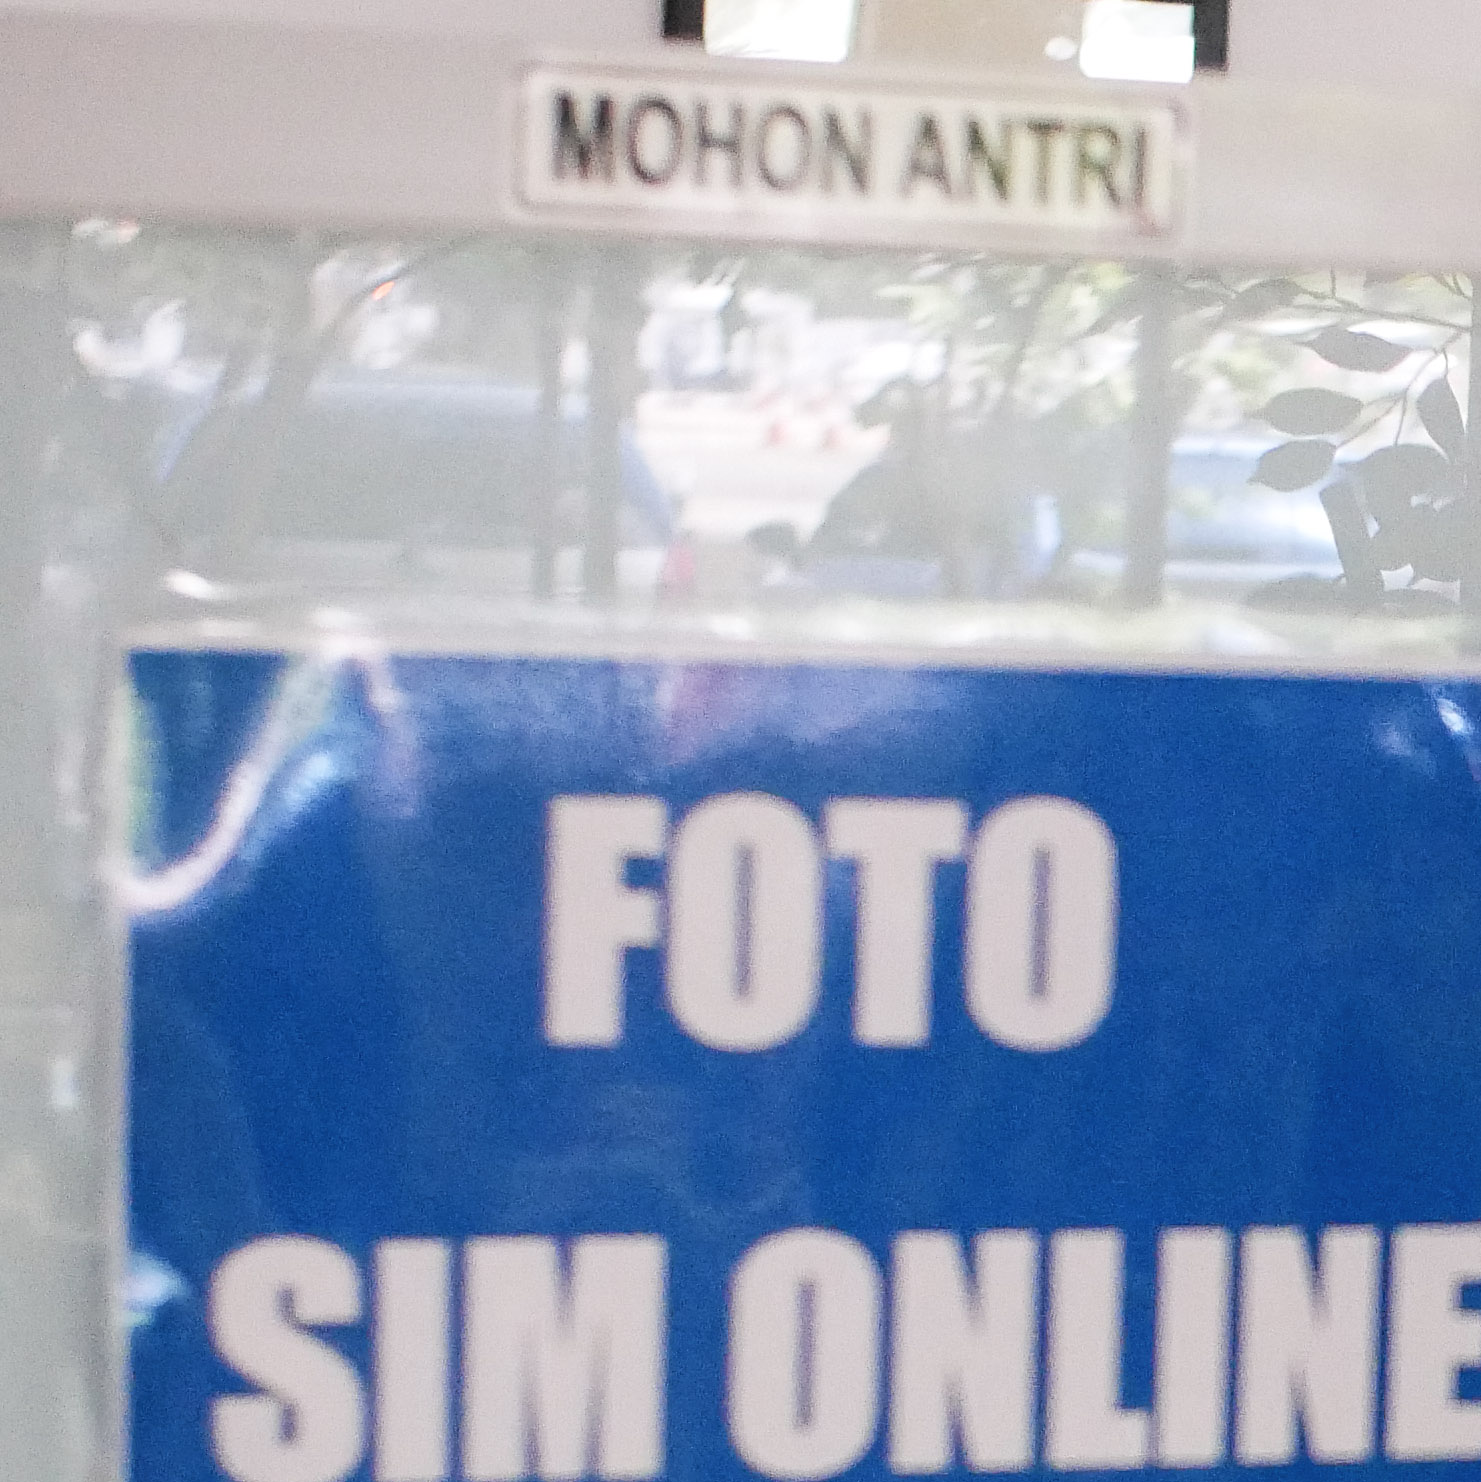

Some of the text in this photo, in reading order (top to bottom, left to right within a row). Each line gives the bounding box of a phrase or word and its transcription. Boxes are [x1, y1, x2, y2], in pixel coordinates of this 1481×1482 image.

[550, 90, 1150, 207] MOHON ANTRI
[545, 792, 1118, 1051] FOTO
